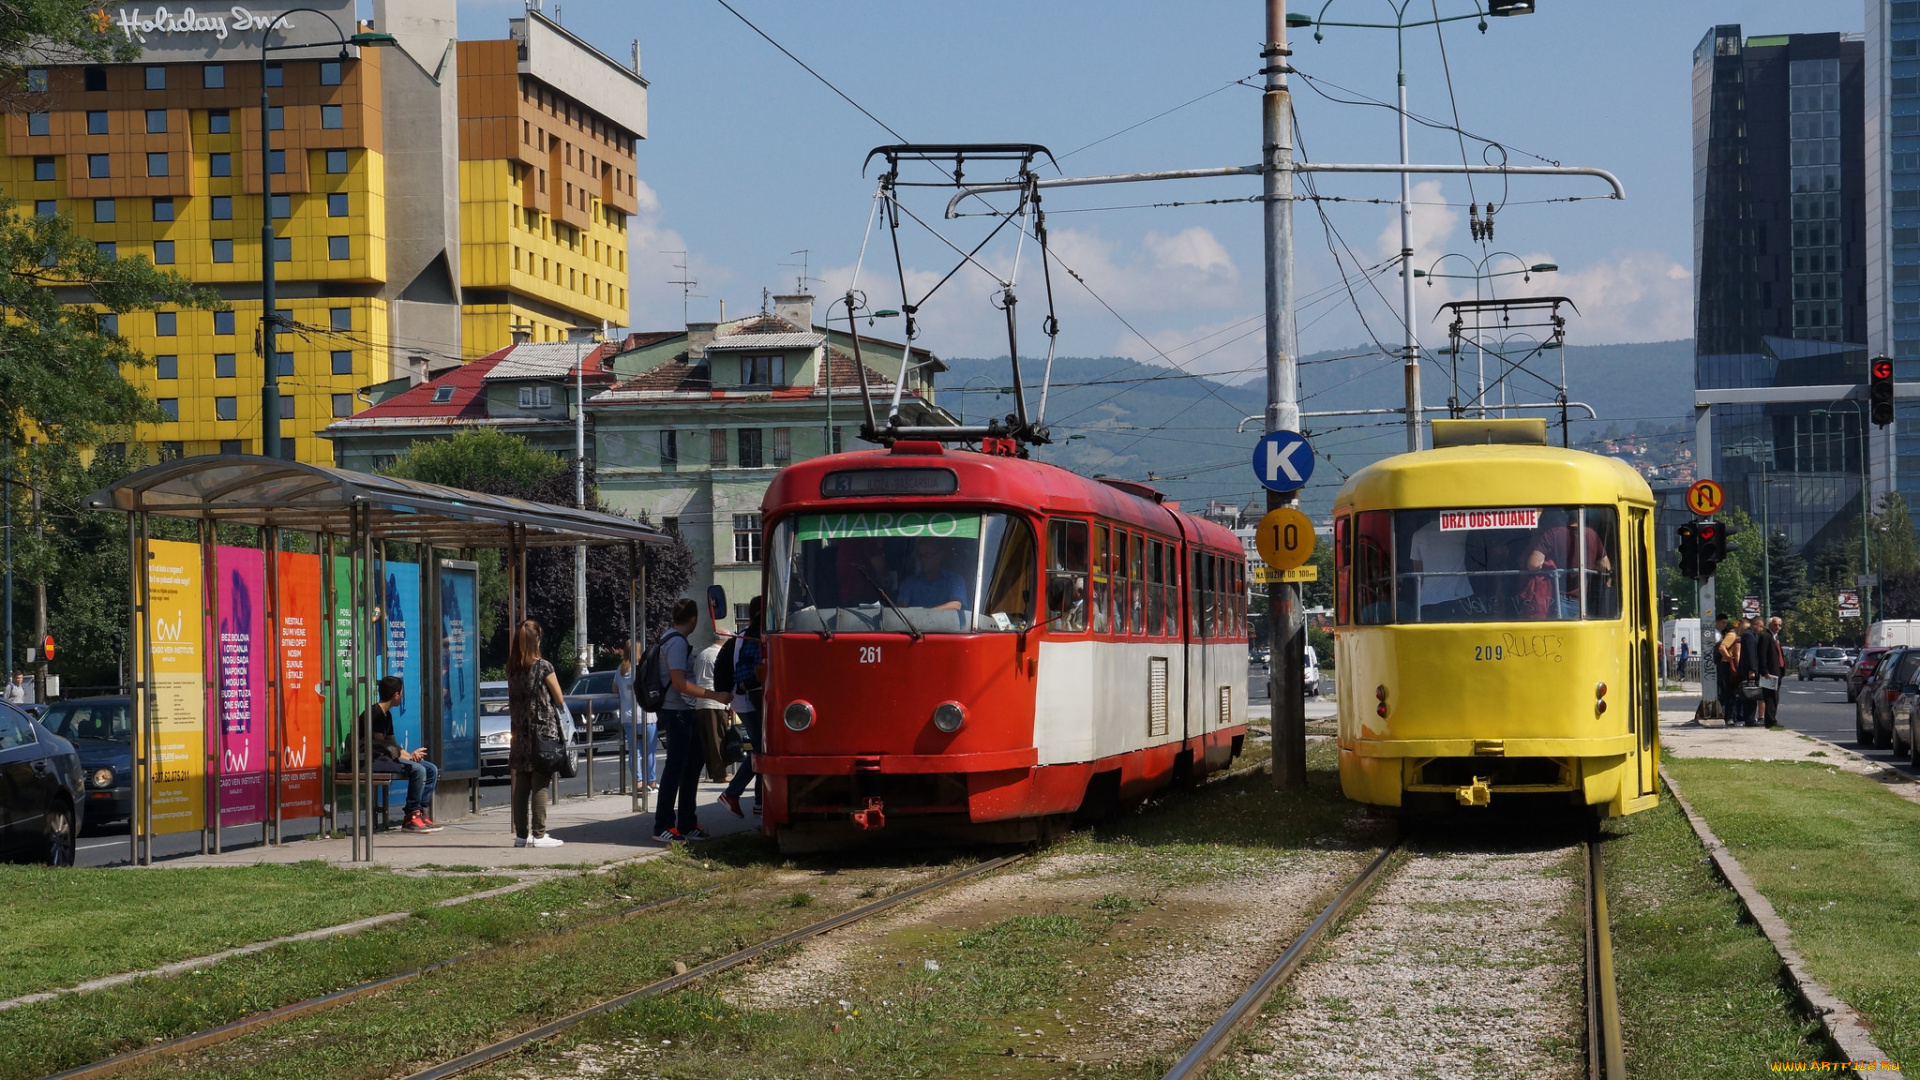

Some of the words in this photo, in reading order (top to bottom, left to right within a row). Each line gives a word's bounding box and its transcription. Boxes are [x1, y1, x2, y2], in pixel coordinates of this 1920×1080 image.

[117, 6, 228, 43] Holiday
[231, 5, 295, 31] Inn
[1266, 440, 1303, 482] K
[818, 512, 957, 538] MARGO
[1442, 512, 1466, 529] DRŽI
[1469, 510, 1535, 528] ODSTOJANJE
[1272, 523, 1298, 551] 10
[1256, 571, 1264, 579] NA
[1288, 570, 1295, 578] OD
[860, 646, 881, 663] 261
[1475, 645, 1503, 661] 209
